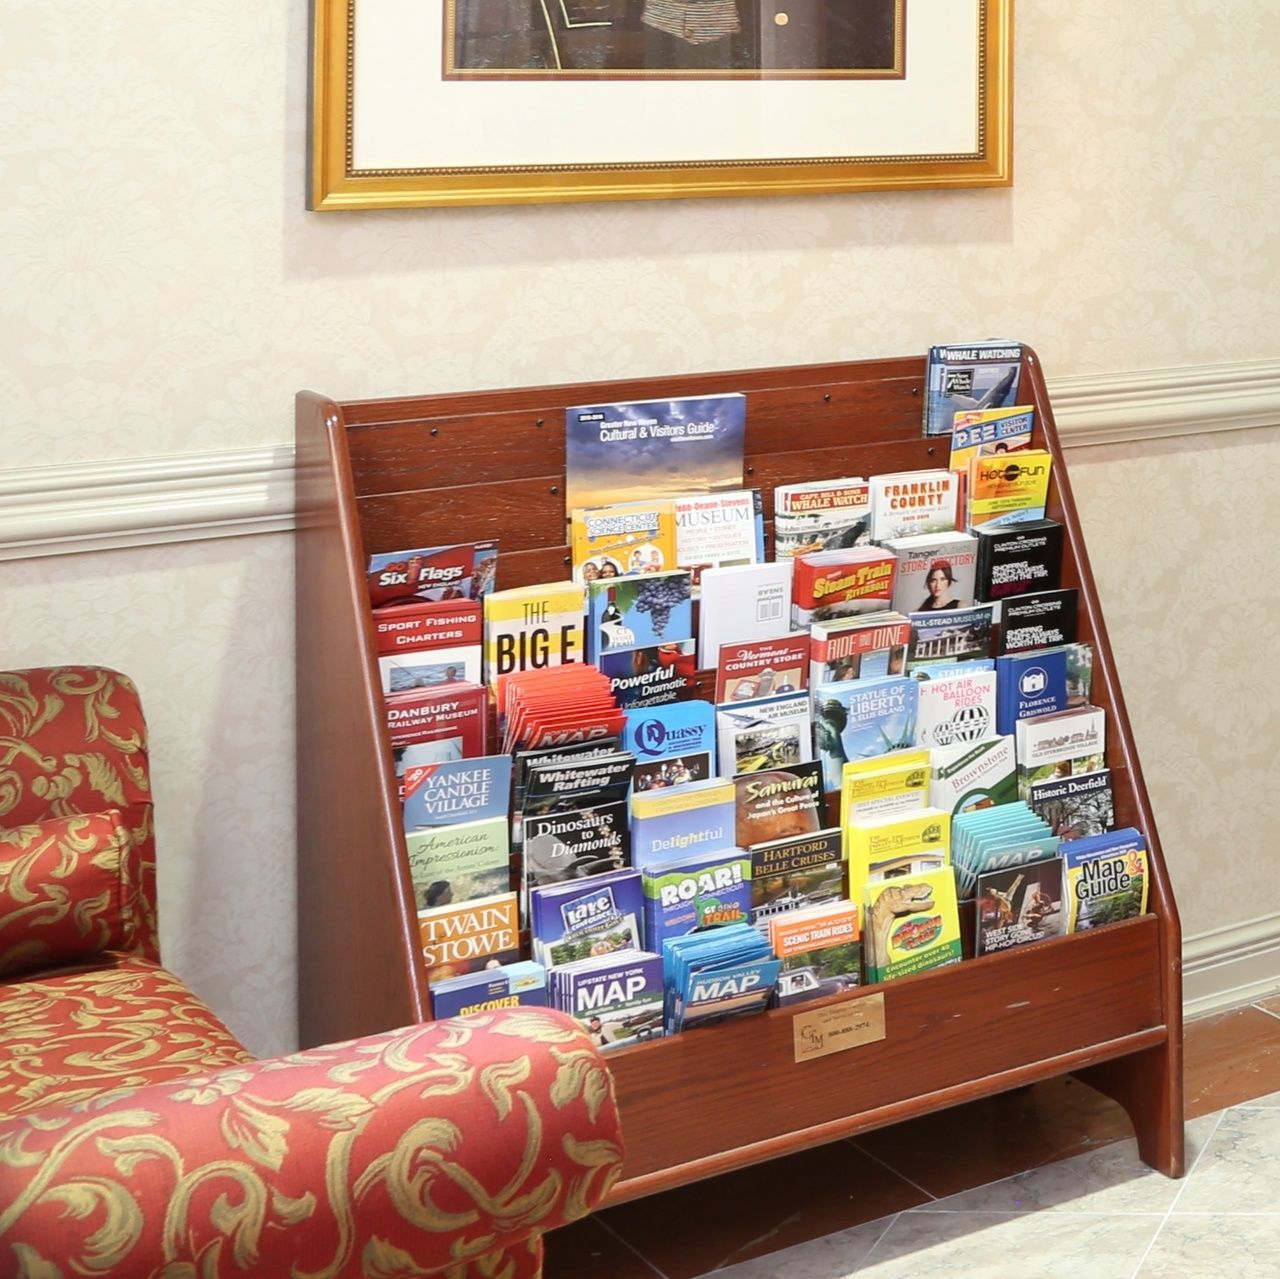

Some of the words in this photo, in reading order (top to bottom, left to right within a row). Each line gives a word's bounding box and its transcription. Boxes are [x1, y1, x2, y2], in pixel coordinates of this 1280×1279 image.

[947, 350, 978, 360] WHALE
[979, 348, 1021, 360] WATCHING
[1001, 416, 1028, 428] VISITOR
[1001, 424, 1029, 436] CENTER
[600, 427, 638, 442] Cultural
[639, 427, 648, 439] &
[649, 425, 686, 438] Visitors
[687, 422, 715, 435] Guide
[884, 480, 950, 498] FRANKLIN
[791, 496, 831, 511] WHALE
[833, 493, 868, 507] WATCH
[890, 494, 944, 509] COUNTY
[588, 512, 657, 527] CONNECTICUT
[675, 507, 750, 527] MUSEUM
[588, 525, 623, 536] SCIENCE
[625, 522, 657, 532] CENTER
[378, 572, 408, 586] Six
[419, 565, 465, 581] Flags
[901, 558, 928, 574] STORE
[992, 561, 1029, 571] SHOPPING
[813, 574, 856, 599] Steam
[857, 562, 893, 586] Train
[991, 576, 1019, 585] WORTH
[1020, 572, 1033, 580] THE
[523, 600, 550, 626] THE
[911, 617, 953, 627] HILL-STEAD
[953, 613, 984, 624] MUSEUM
[378, 620, 421, 632] SPORT
[425, 615, 477, 627] FISHING
[1006, 625, 1043, 635] SHOPPING
[396, 631, 463, 645] CHARTERS
[827, 634, 857, 661] RIDE
[872, 625, 904, 650] DINE
[1005, 640, 1033, 650] WORTH
[1034, 637, 1048, 645] THE
[496, 628, 550, 676] BIG
[560, 624, 577, 665] E
[737, 647, 789, 661] Vermont
[725, 658, 772, 671] COUNTRY
[774, 653, 804, 665] STORE
[610, 664, 675, 692] Powerful
[641, 677, 687, 697] Dramatic
[931, 682, 953, 694] HOT
[956, 680, 973, 689] AIR
[850, 688, 888, 704] STATUE
[890, 685, 906, 697] OF
[943, 685, 991, 701] BALLOON
[954, 695, 983, 707] RIDES
[388, 701, 459, 720] DANBURY
[760, 706, 774, 714] NEW
[776, 700, 808, 711] ENGLAND
[850, 694, 905, 716] LIBERTY
[1019, 696, 1057, 710] FLORENCE
[1019, 704, 1058, 718] GRISWOLD
[387, 716, 433, 729] RAILWAY
[435, 708, 478, 722] MUSEUM
[767, 712, 779, 720] AIR
[780, 707, 808, 718] MUSEUM
[539, 728, 608, 747] MAP
[634, 718, 705, 756] Quassy
[526, 747, 616, 767] Whitewater
[539, 764, 629, 783] Whitewater
[951, 746, 1009, 789] Brownstone
[425, 768, 492, 789] YANKEE
[552, 776, 611, 792] Rafting
[745, 771, 818, 803] Samurai
[1032, 785, 1067, 801] Historic
[1068, 775, 1109, 794] Deerfield
[424, 780, 493, 802] CANDLE
[425, 794, 489, 814] VILLAGE
[755, 800, 771, 809] and
[772, 798, 784, 806] the
[778, 804, 799, 814] Great
[537, 813, 614, 837] Dinosaurs
[581, 828, 594, 840] to
[417, 833, 489, 854] American
[552, 832, 622, 858] Diamonds
[651, 827, 723, 852] Delightful
[763, 840, 828, 862] HARTFORD
[985, 849, 1043, 870] MAP
[755, 861, 790, 877] BELLE
[791, 851, 836, 869] CRUISES
[1081, 857, 1126, 884] Map
[1127, 849, 1144, 877] &
[660, 864, 742, 907] ROAR!
[1075, 872, 1131, 899] Guide
[567, 896, 611, 926] Lake
[703, 910, 743, 925] TRAIL
[704, 905, 716, 915] CT
[421, 904, 513, 942] TWAIN
[985, 926, 1007, 938] WEST
[783, 932, 810, 947] SCENIC
[811, 927, 832, 940] TRAIN
[832, 923, 853, 936] RIDES
[985, 933, 1010, 946] STORY
[422, 928, 515, 968] STOWE
[886, 954, 922, 973] Encounter
[923, 949, 940, 959] over
[577, 974, 607, 987] UPSTATE
[608, 972, 624, 980] NEW
[624, 967, 644, 978] YORK
[696, 975, 731, 985] HUDSON
[732, 969, 761, 979] VALLEY
[576, 975, 646, 1012] MAP
[691, 974, 760, 1002] MAP
[459, 995, 520, 1017] DISCOVER
